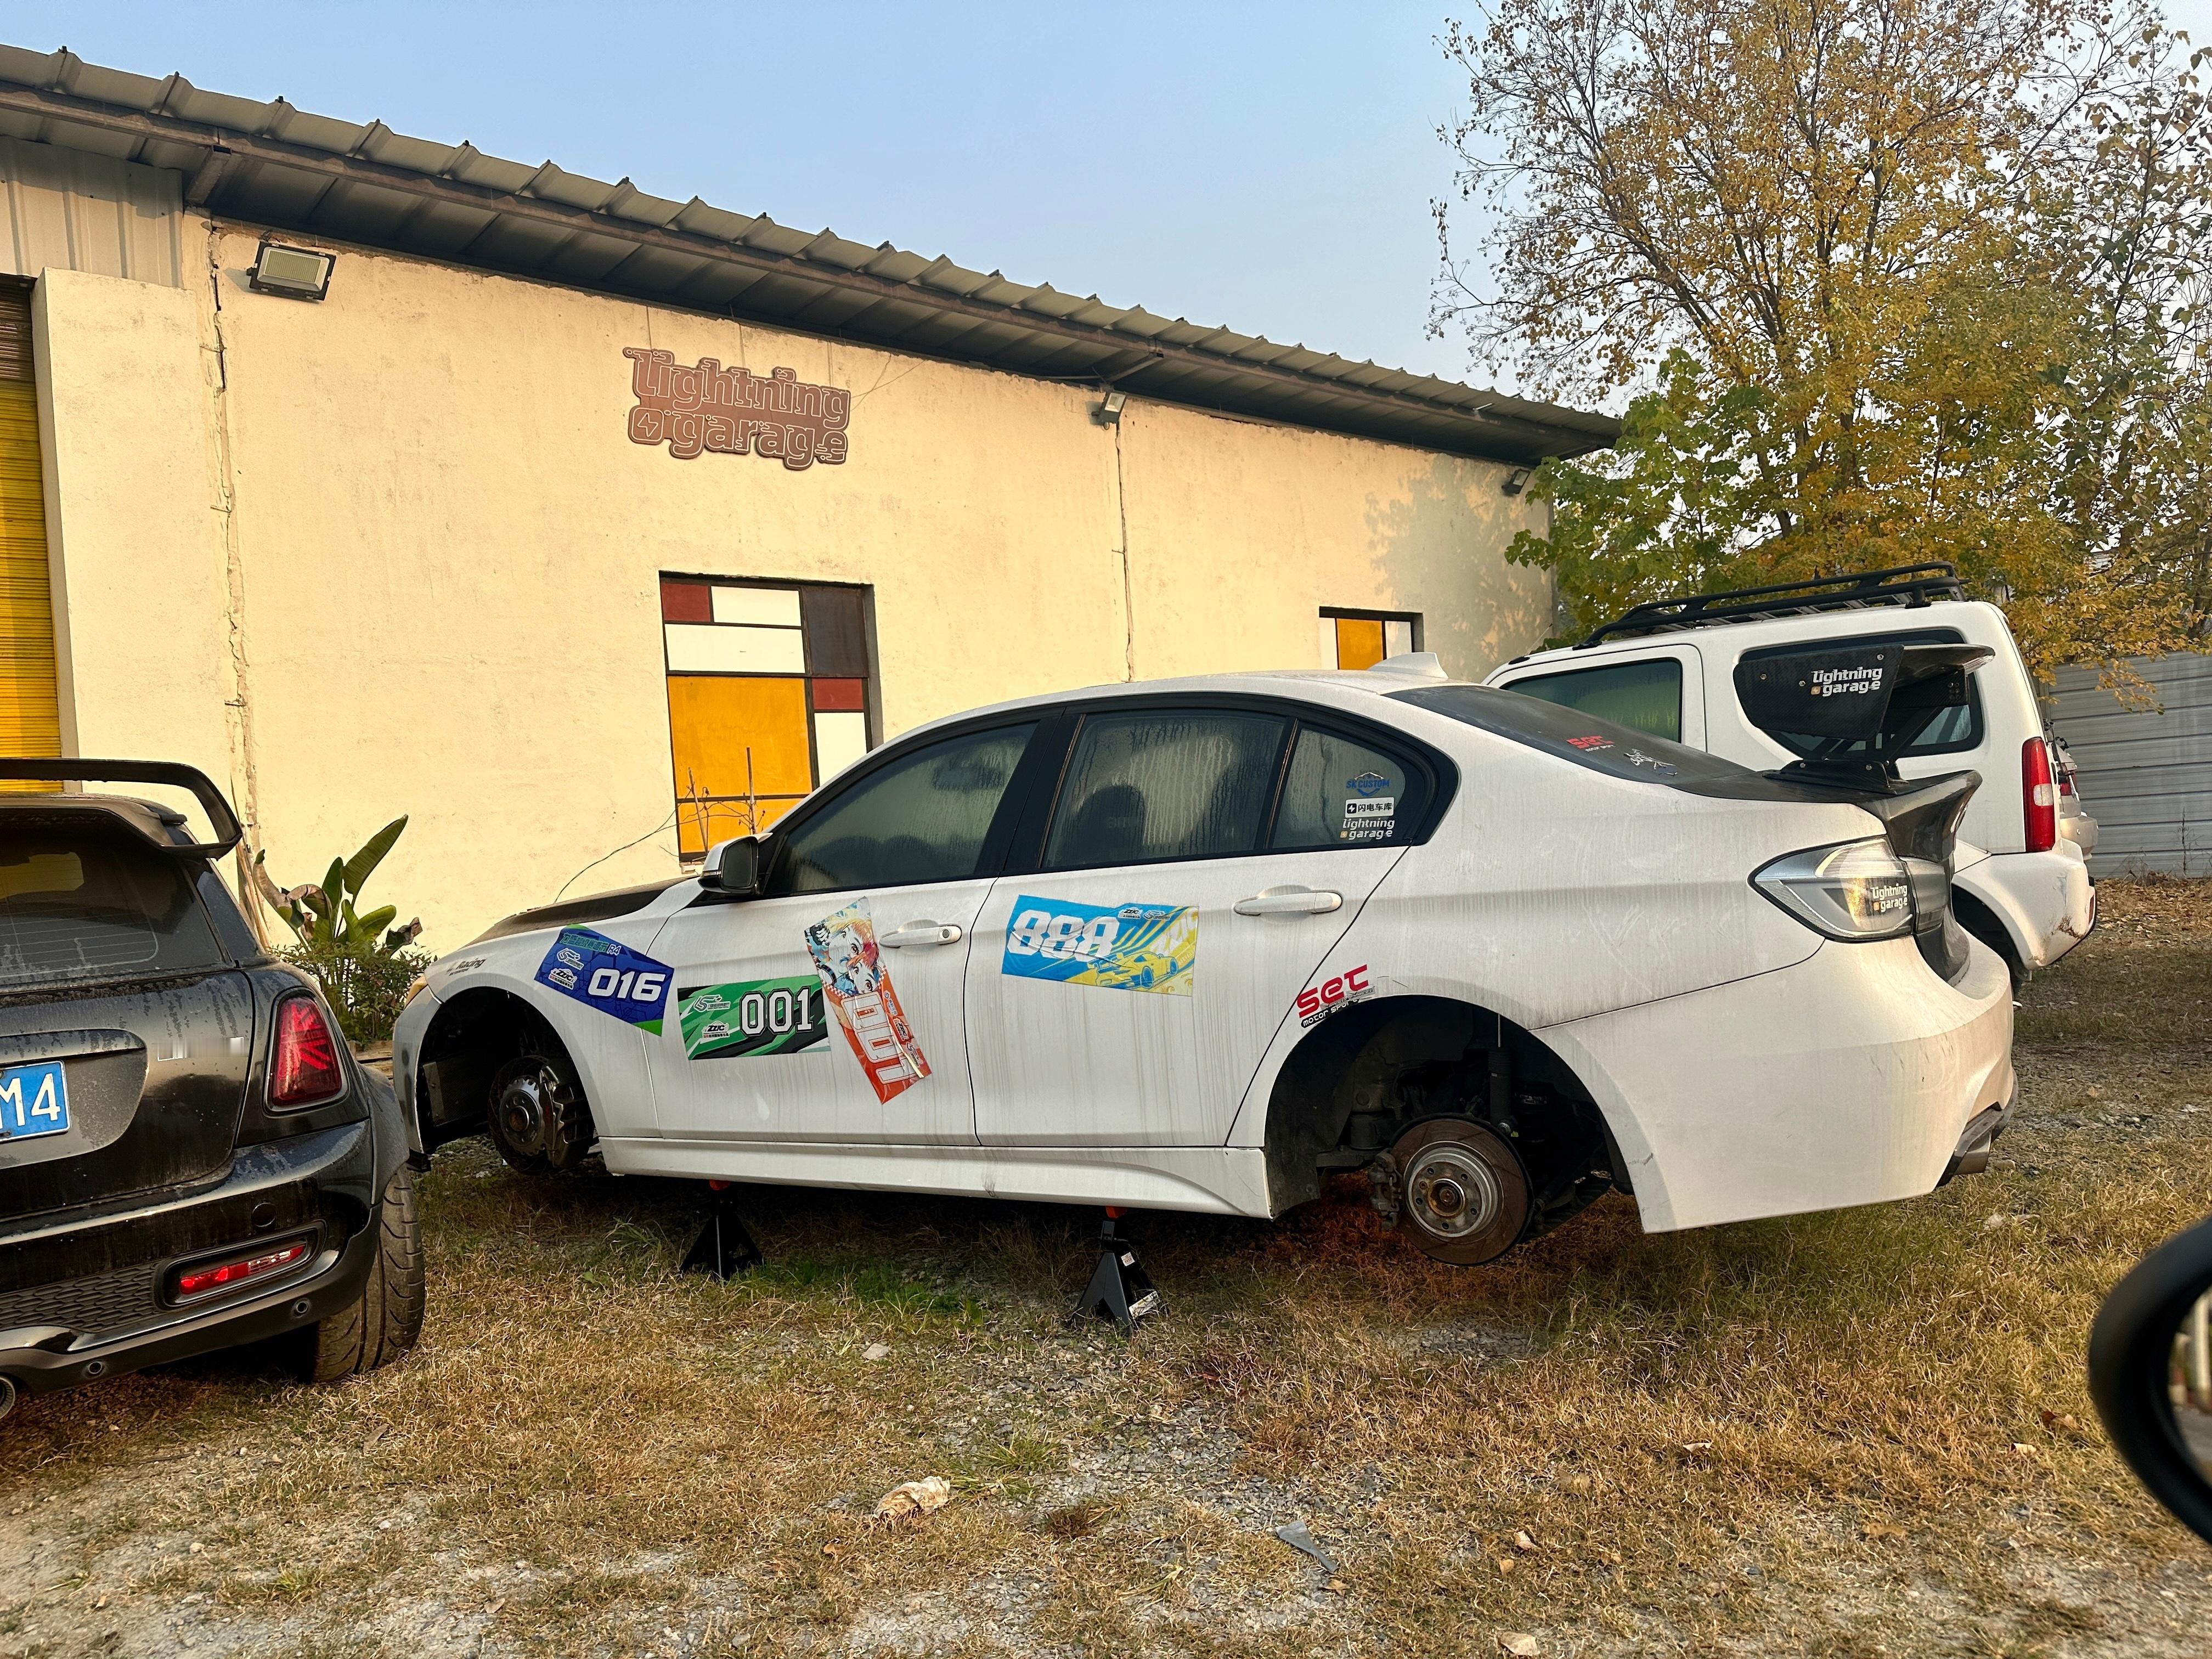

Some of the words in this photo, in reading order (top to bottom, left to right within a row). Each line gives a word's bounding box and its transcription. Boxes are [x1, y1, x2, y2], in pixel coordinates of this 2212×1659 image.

[665, 410, 848, 470] garage
[1822, 680, 1881, 697] garage
[1358, 779, 1390, 788] CUSTOM
[1358, 803, 1392, 811] 闪电车库
[1348, 829, 1392, 840] garage
[1880, 897, 1908, 912] garage
[1007, 910, 1120, 962] 888
[607, 944, 622, 956] R4
[588, 968, 666, 1002] 016
[740, 986, 813, 1036] 001
[0, 1073, 60, 1128] M4
